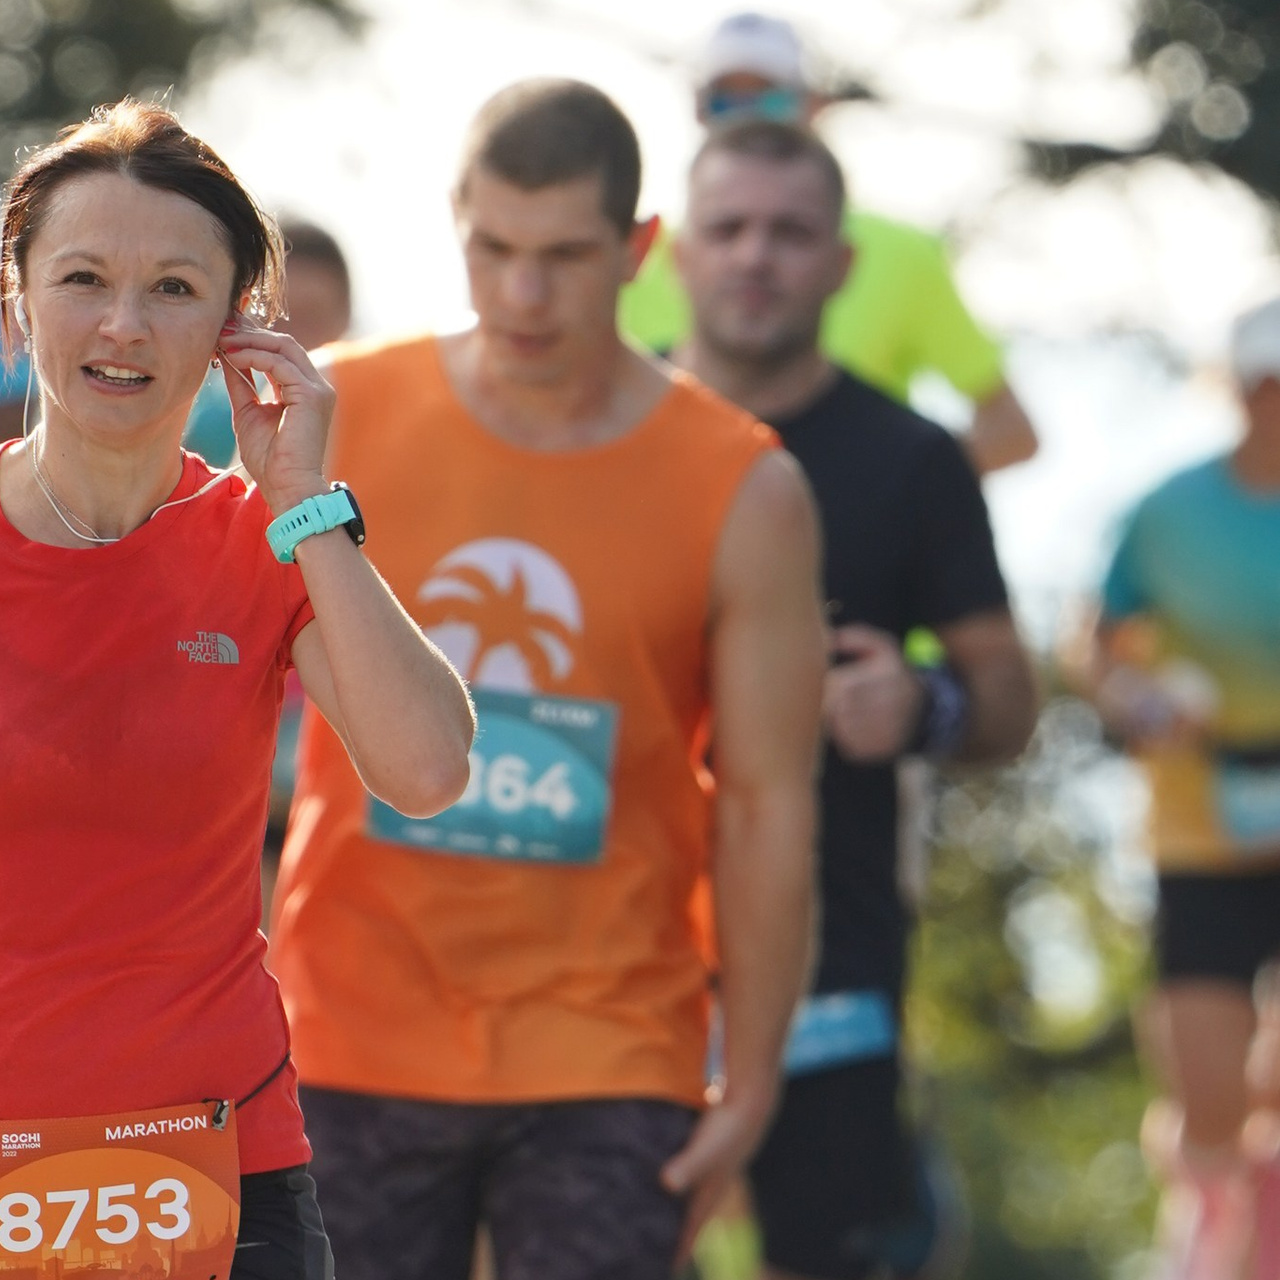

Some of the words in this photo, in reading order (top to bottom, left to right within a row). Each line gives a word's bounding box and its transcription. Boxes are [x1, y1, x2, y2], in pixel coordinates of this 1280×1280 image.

[196, 631, 217, 642] THE
[177, 640, 218, 653] NORTH
[188, 651, 218, 663] FACE
[105, 1115, 208, 1141] MARATHON
[1, 1132, 41, 1144] SOCHI
[1, 1142, 41, 1150] MARATHON
